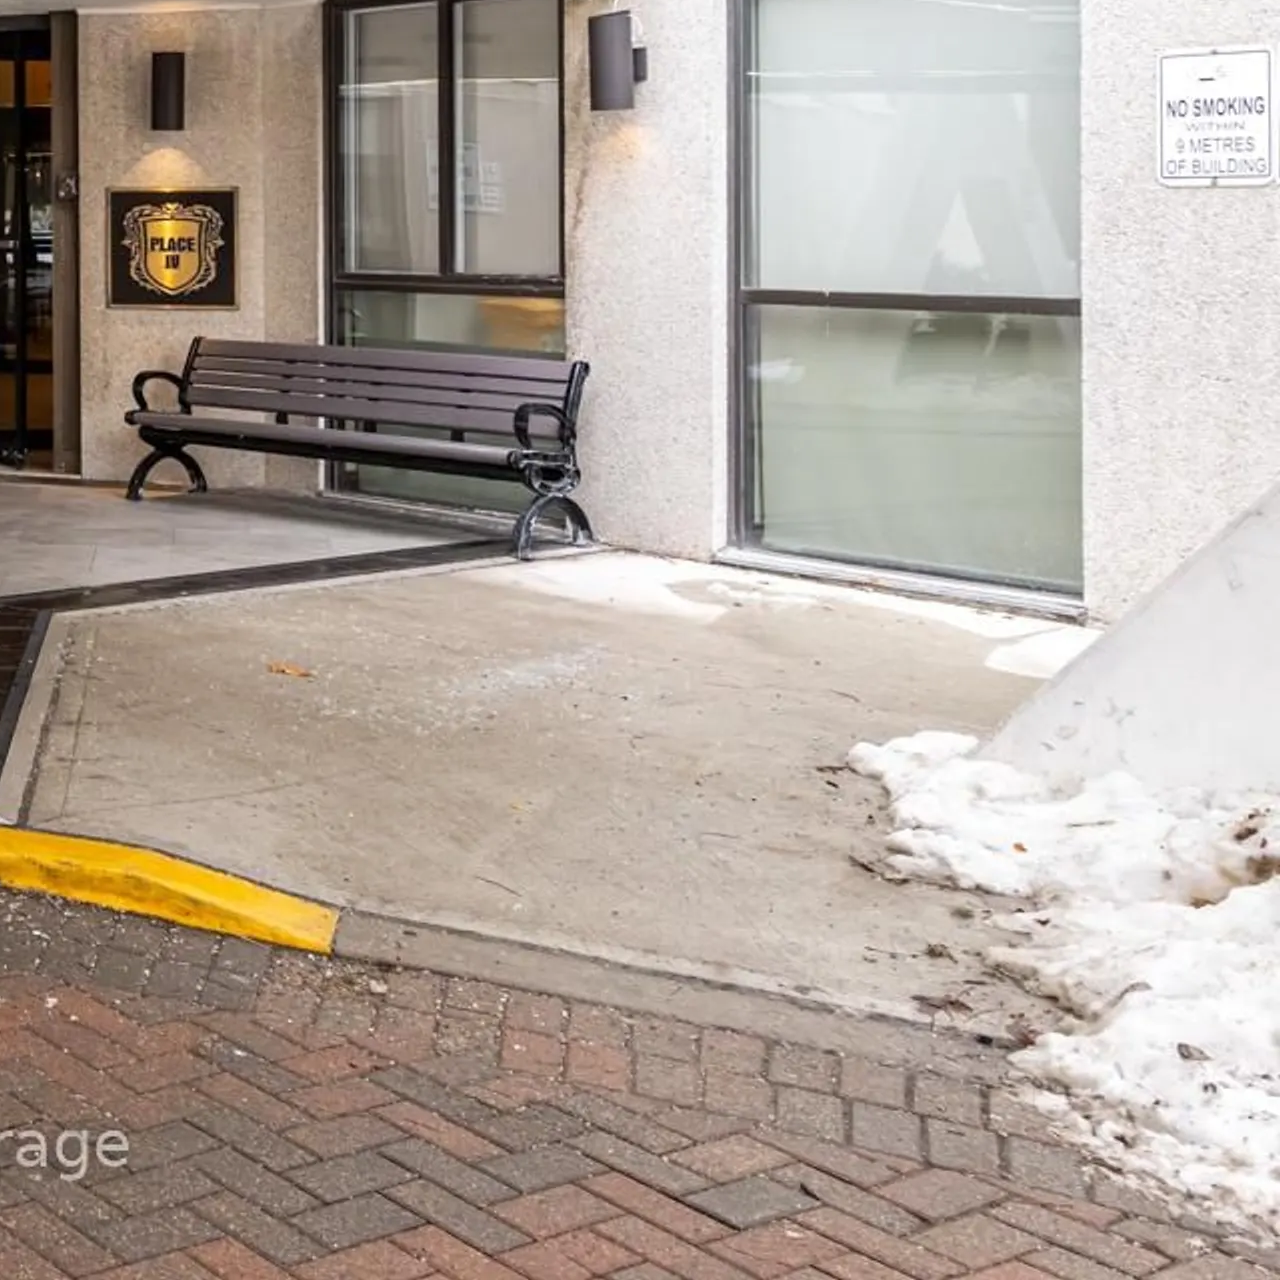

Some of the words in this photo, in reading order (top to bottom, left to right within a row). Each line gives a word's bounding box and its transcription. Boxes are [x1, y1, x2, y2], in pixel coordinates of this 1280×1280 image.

[1166, 99, 1188, 118] NO
[1192, 96, 1264, 116] SMOKING
[1186, 122, 1246, 132] WITHIN
[1176, 138, 1184, 152] 9
[1190, 136, 1256, 152] METRES
[1166, 160, 1188, 174] OF
[1192, 158, 1268, 174] BUILDING
[150, 236, 196, 252] PLACE
